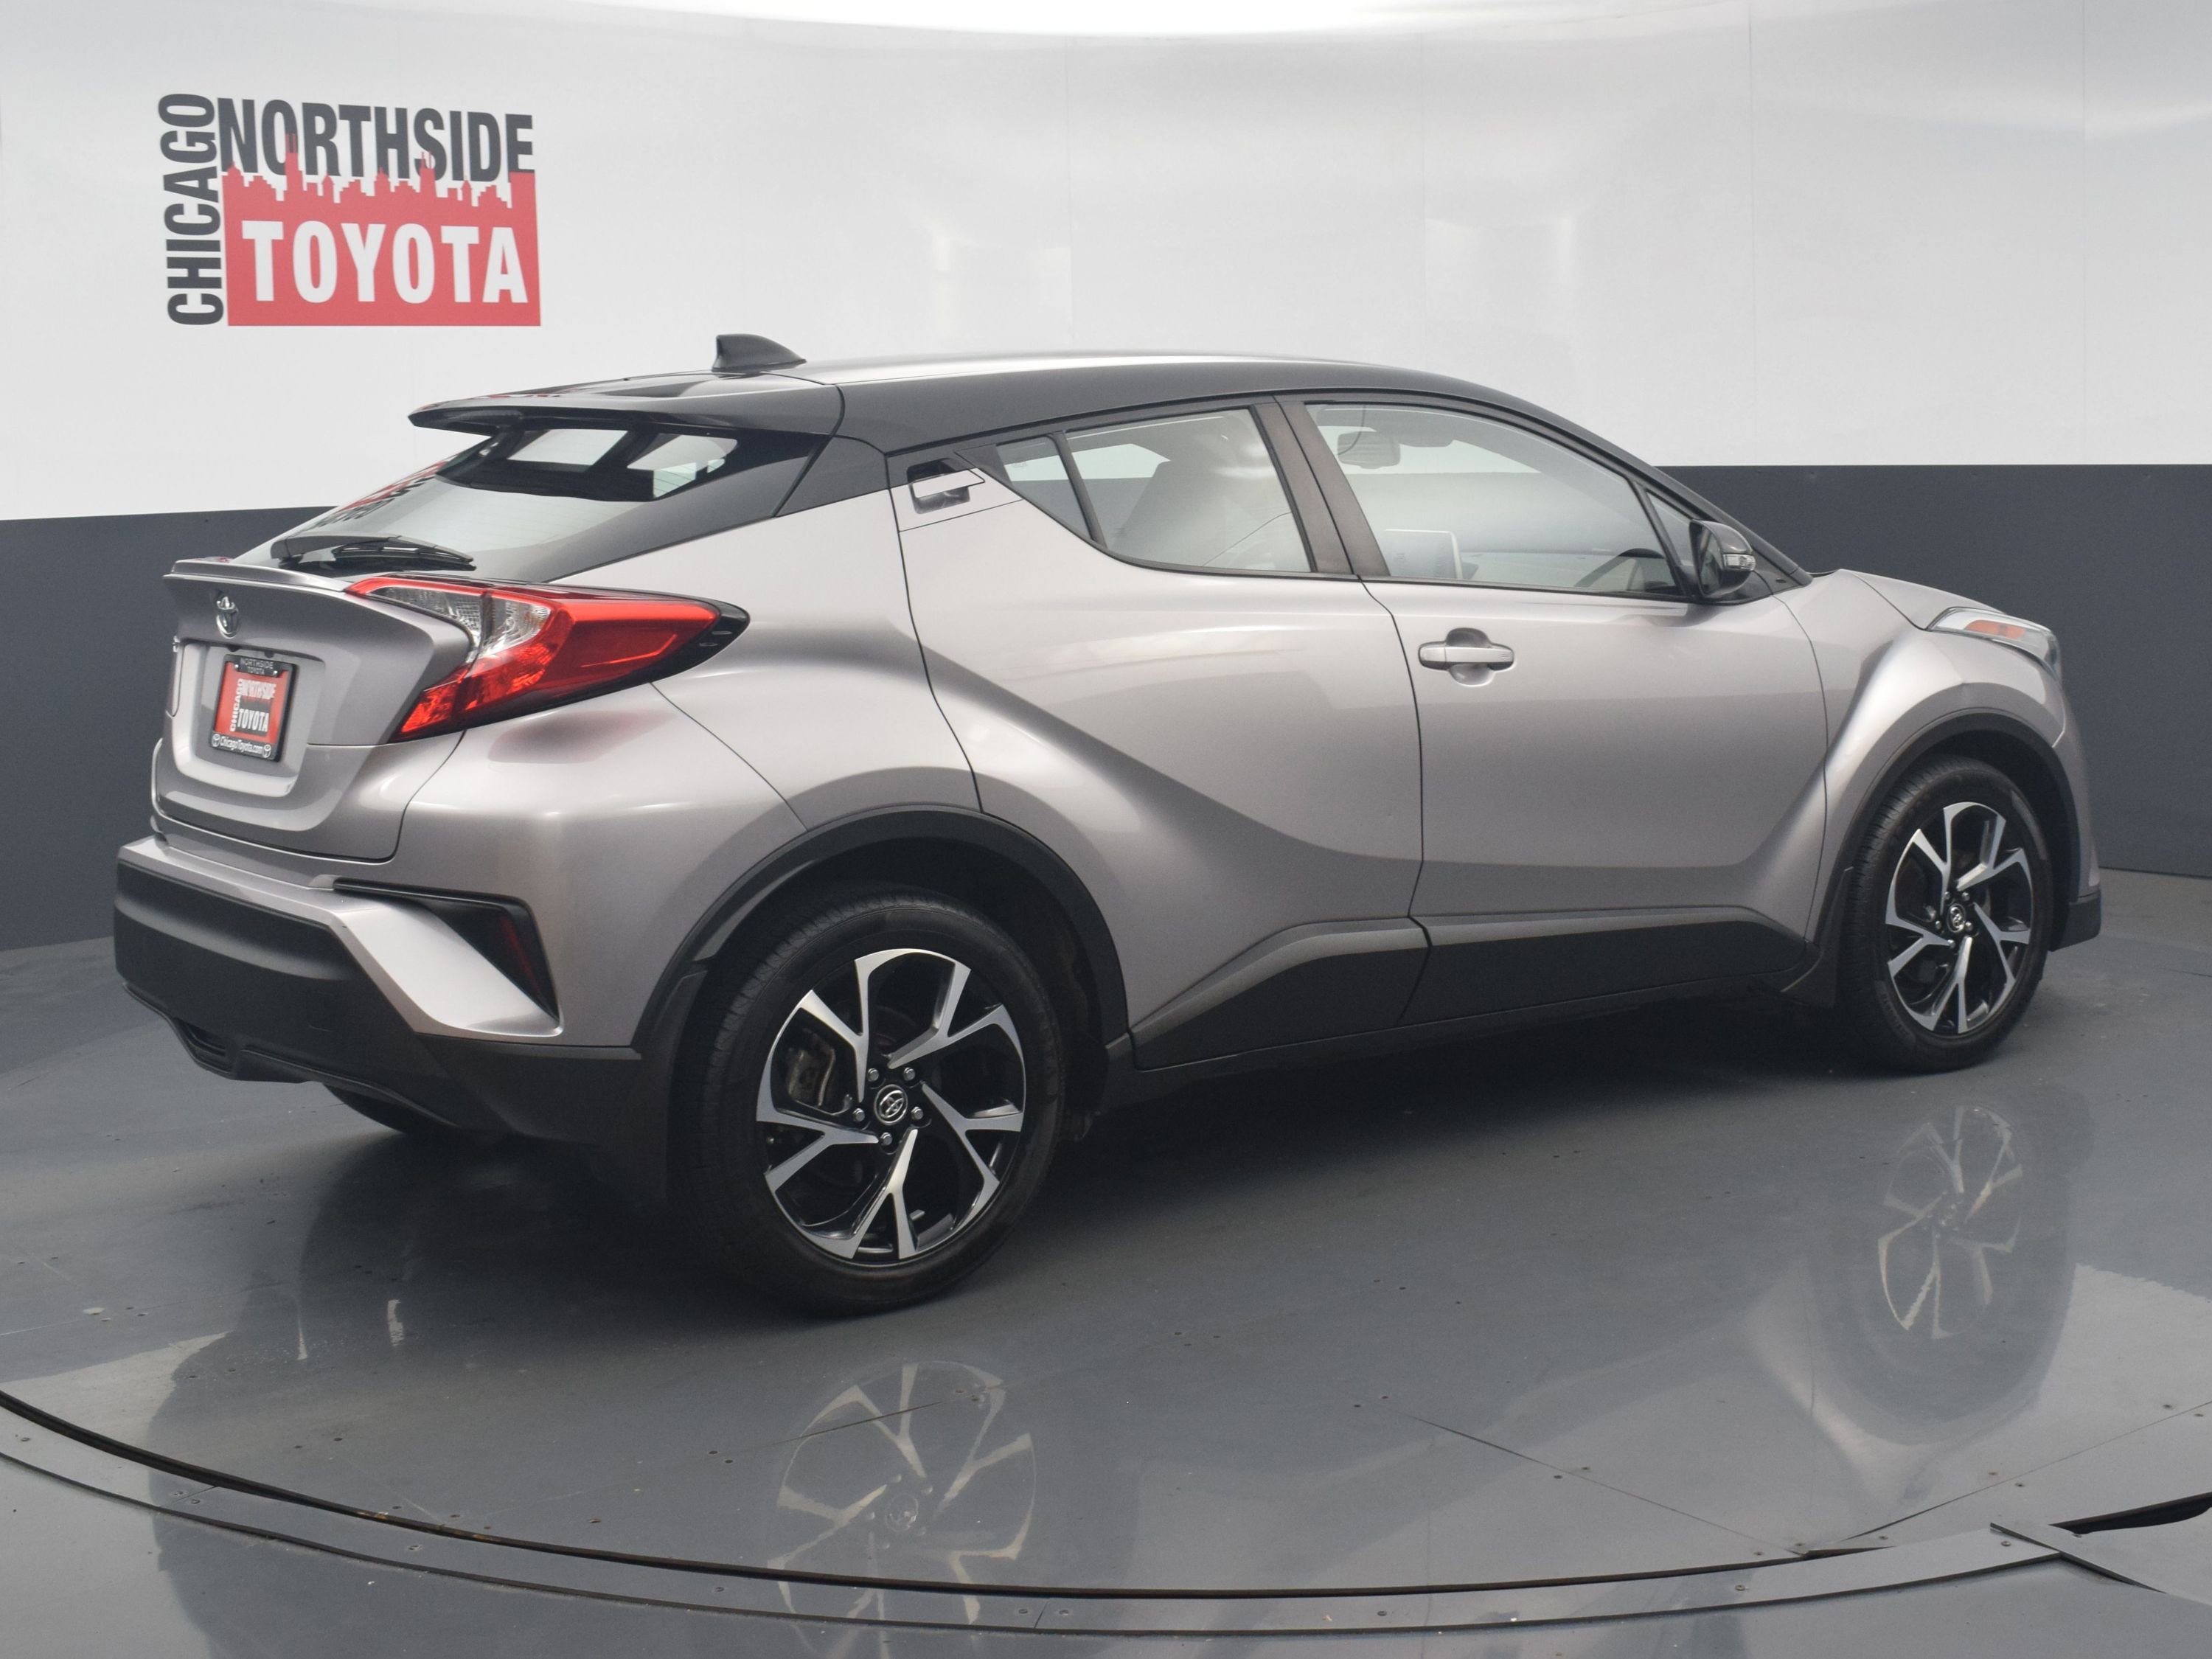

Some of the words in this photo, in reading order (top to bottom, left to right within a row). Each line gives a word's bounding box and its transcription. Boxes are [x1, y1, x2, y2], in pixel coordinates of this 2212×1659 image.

[218, 97, 535, 183] NORTHSIDE
[158, 94, 223, 325] CHICAGO
[241, 220, 528, 304] TOYOTA
[237, 708, 269, 731] TOYOTA
